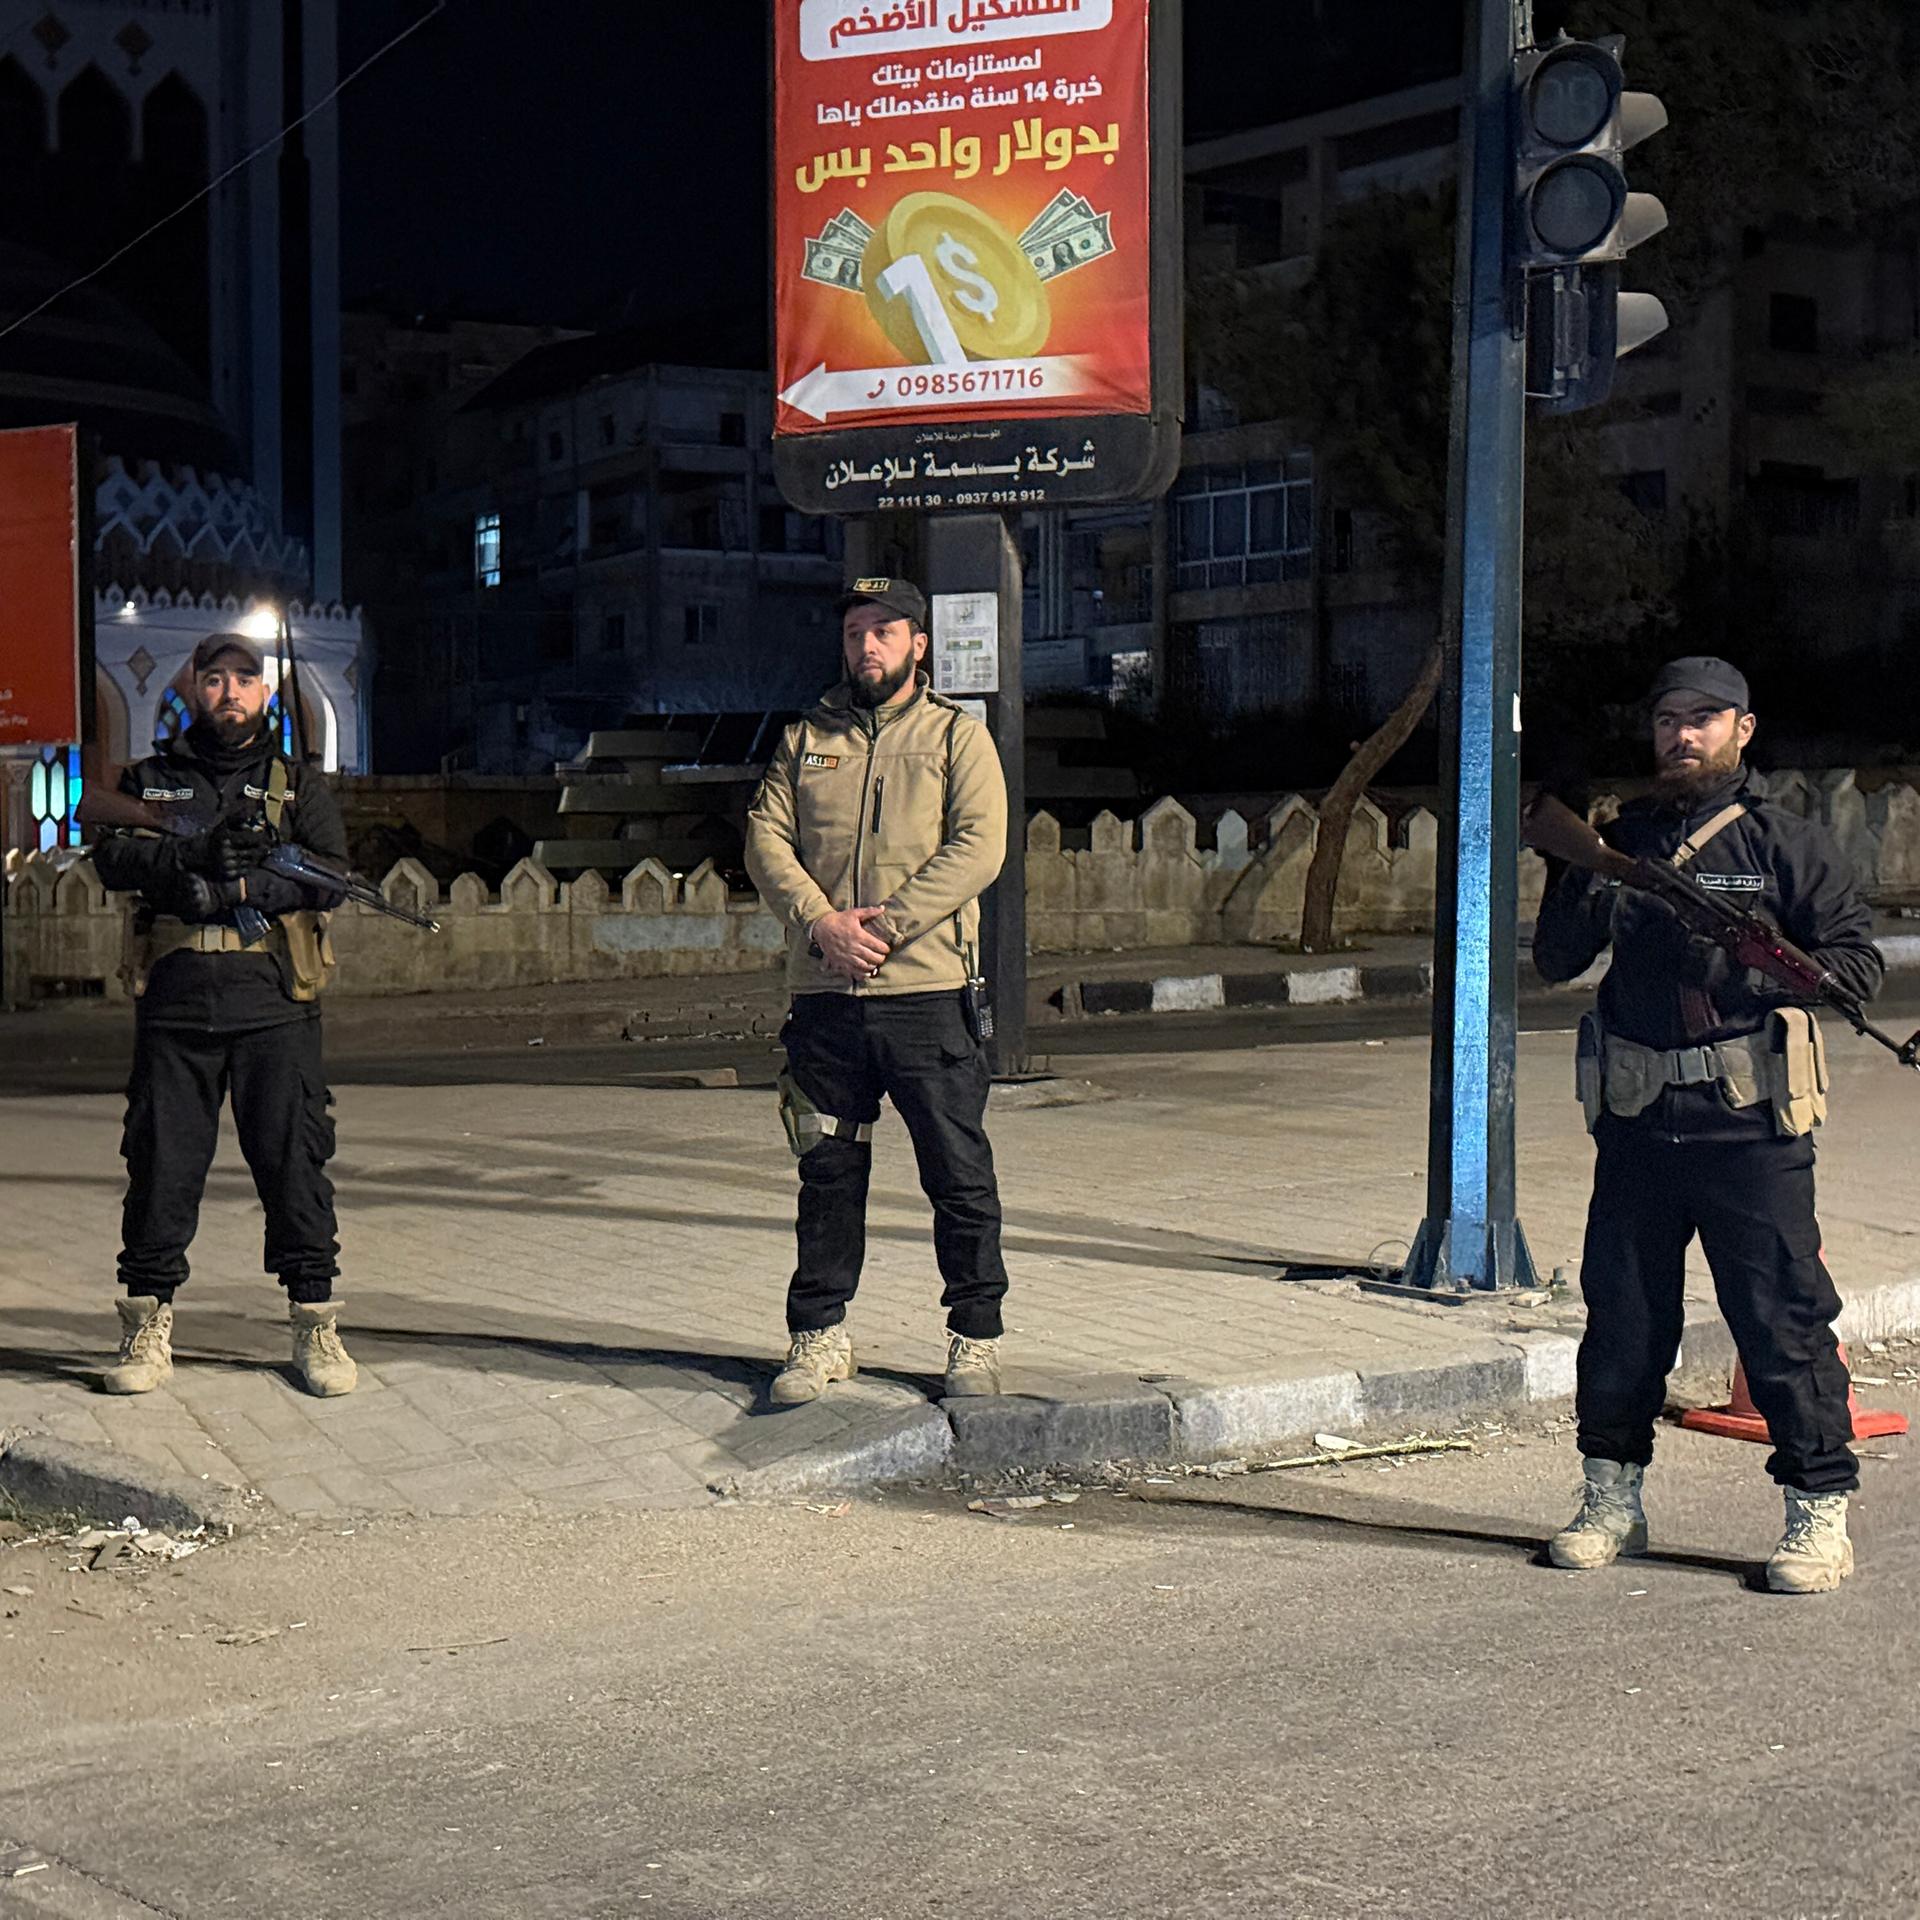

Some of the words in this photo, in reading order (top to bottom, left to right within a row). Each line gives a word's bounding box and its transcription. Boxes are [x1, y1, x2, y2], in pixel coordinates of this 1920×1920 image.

[829, 0, 937, 48] الأضخم
[872, 63, 920, 89] بيتك
[926, 48, 1042, 84] لمستلزمات
[866, 91, 965, 119] منقدملك
[970, 84, 1019, 109] سنة
[1024, 80, 1048, 103] 14
[1053, 75, 1102, 106] خبرة
[817, 101, 862, 127] ياها
[884, 127, 981, 180] واحد
[993, 117, 1120, 176] بدولار
[795, 147, 872, 193] بس
[897, 367, 1043, 397] 0985671716
[825, 456, 917, 490] للإعلان
[923, 451, 1021, 482] بسمة
[1025, 439, 1096, 477] شركة
[878, 496, 894, 508] 22
[898, 495, 921, 507] 111
[925, 494, 941, 506] 30
[956, 492, 988, 504] 0937
[991, 490, 1017, 503] 912
[1020, 489, 1046, 501] 912
